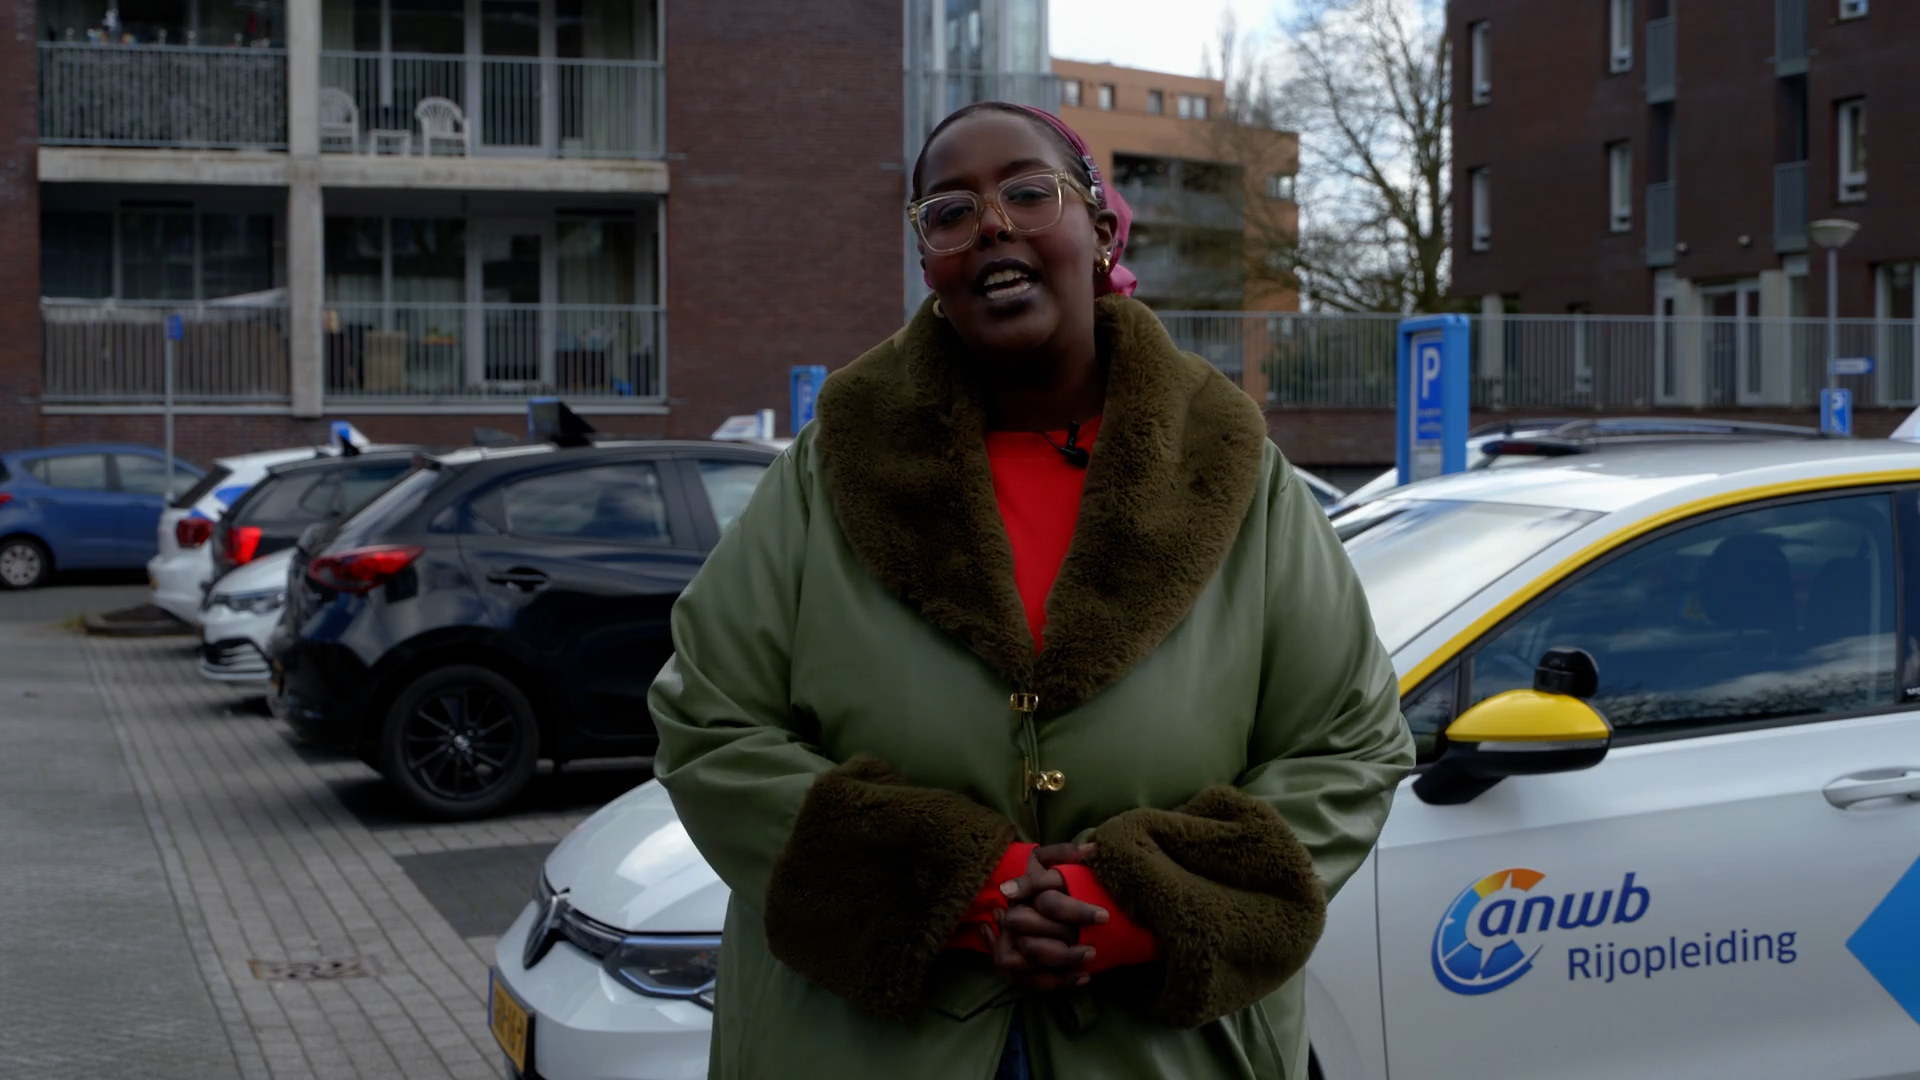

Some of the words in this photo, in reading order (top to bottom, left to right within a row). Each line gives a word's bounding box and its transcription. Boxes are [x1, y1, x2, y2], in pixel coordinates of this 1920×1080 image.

[1422, 348, 1440, 399] P
[1478, 872, 1650, 937] anwb
[1568, 929, 1798, 983] Rijopleiding
